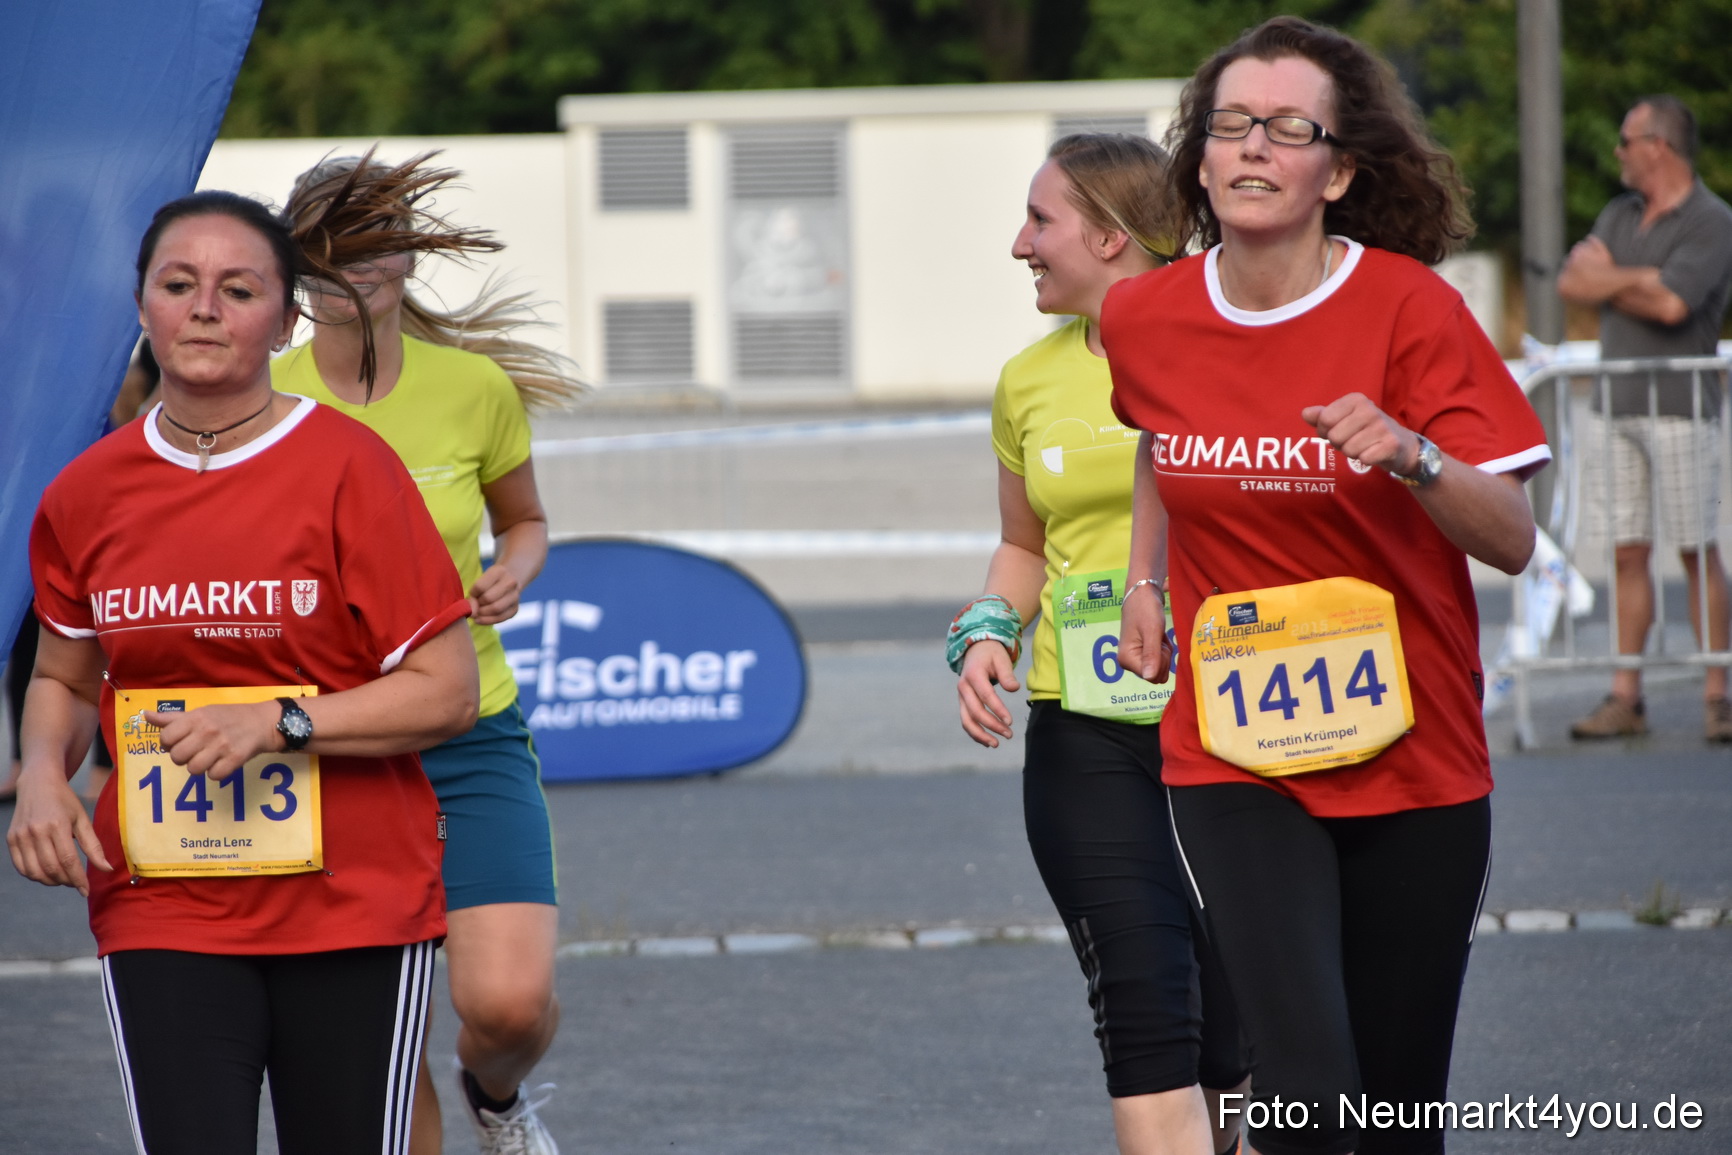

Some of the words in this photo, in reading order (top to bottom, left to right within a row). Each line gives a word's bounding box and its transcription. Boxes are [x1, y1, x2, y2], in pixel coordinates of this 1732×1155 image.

[1240, 480, 1291, 492] STARKE
[1294, 482, 1336, 493] STADT
[91, 580, 281, 626] NEUMARKT
[1078, 595, 1124, 610] firmenla
[193, 627, 241, 638] STARKE
[244, 628, 282, 639] STADT
[1218, 616, 1287, 639] firmenlauf
[1201, 644, 1257, 662] walken
[505, 640, 757, 700] Fischer
[1217, 649, 1388, 728] 1414
[1110, 693, 1148, 705] Sandra
[526, 693, 743, 731] AUTOMOBILE
[1257, 734, 1302, 750] Kerstin
[1304, 725, 1358, 743] Krümpel
[1285, 750, 1302, 758] Stadt
[1303, 745, 1334, 755] Neumarkt
[139, 763, 298, 823] 1413
[180, 837, 221, 849] Sandra
[224, 837, 253, 848] Lenz
[209, 852, 239, 860] Neumarkt
